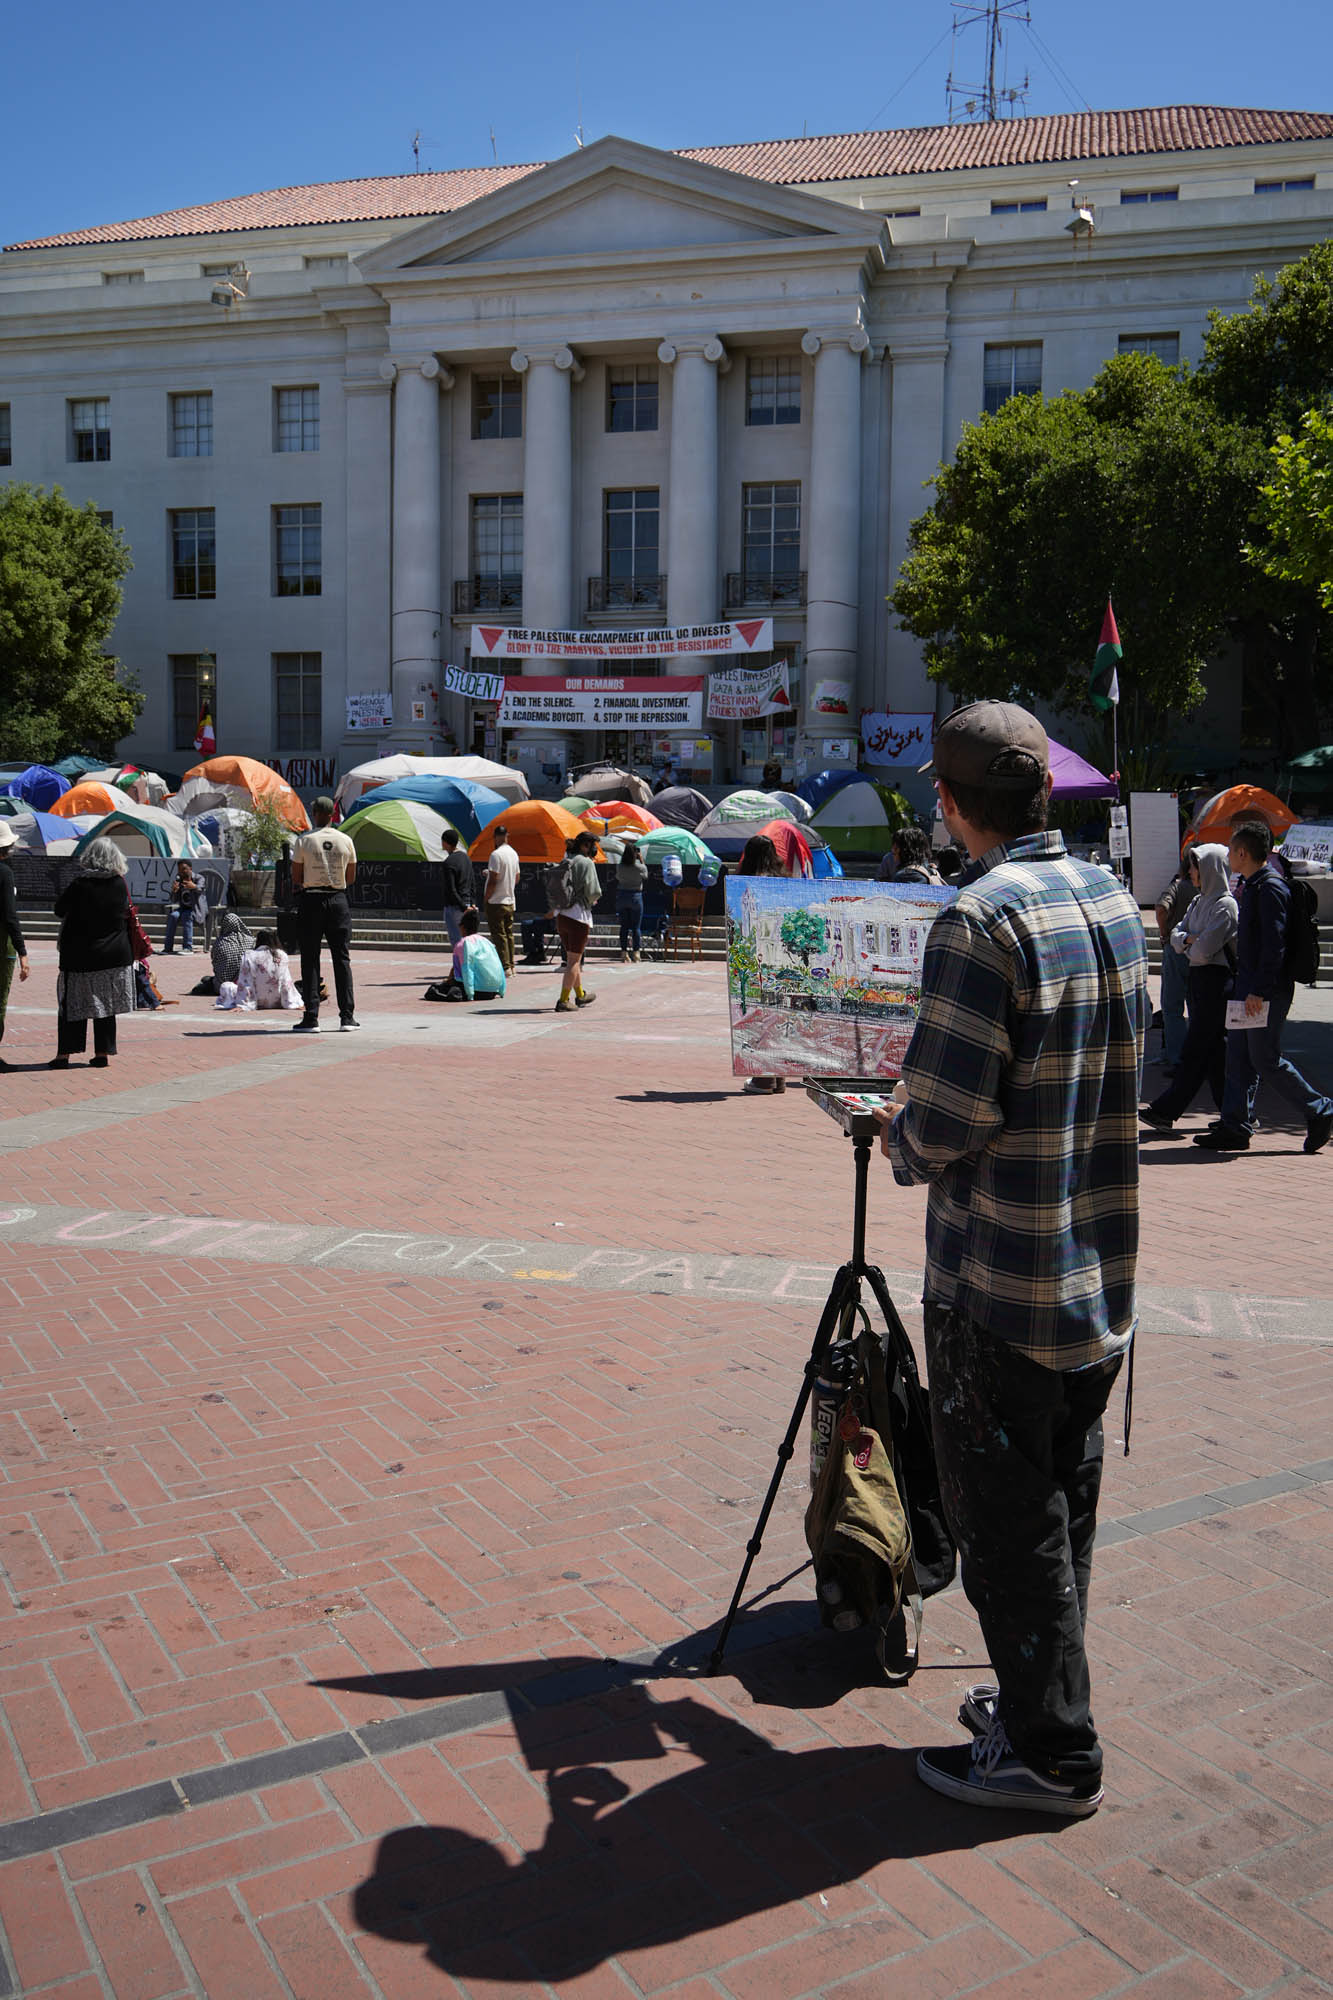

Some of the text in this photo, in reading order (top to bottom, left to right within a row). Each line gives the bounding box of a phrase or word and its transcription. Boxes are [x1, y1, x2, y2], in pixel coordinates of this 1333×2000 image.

[508, 624, 731, 644] FREE PALESTINE ENCAMPMENT UNTIL UC DIVESTS
[507, 642, 531, 653] GLORY
[534, 643, 544, 654] TO
[546, 644, 561, 655] THE
[609, 644, 643, 656] VICTORY
[646, 643, 657, 654] TO
[660, 641, 675, 653] THE
[678, 637, 732, 651] RESISTANCE!
[445, 666, 503, 697] STUDENT
[566, 679, 625, 690] OUR DEMANDS
[505, 697, 575, 708] 1. END THE SILENCE.
[594, 697, 691, 708] 2. FINANCIAL DIVESTMENT.
[503, 711, 586, 723] 3. ACADEMIC BOYCOTT.
[594, 711, 690, 723] 4. STOP THE REPRESSION.
[138, 859, 177, 877] VIV
[312, 1231, 527, 1274] FOR
